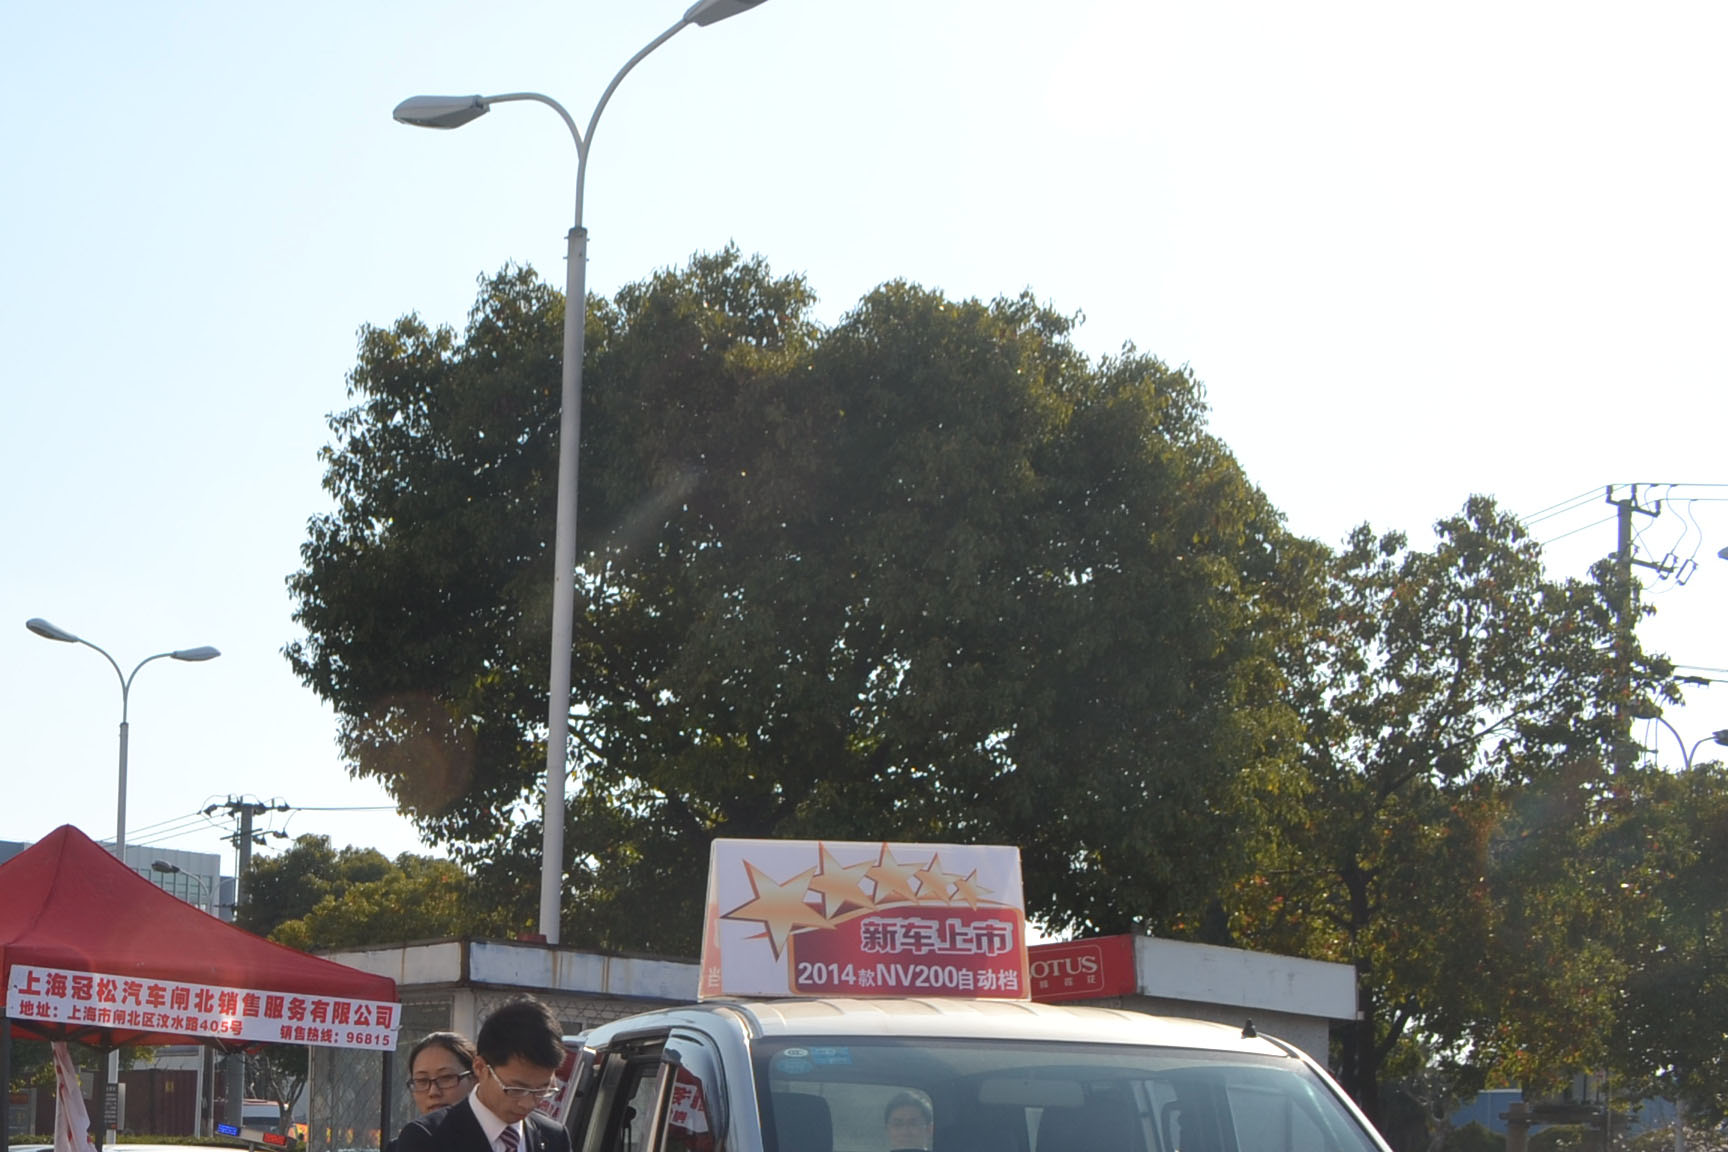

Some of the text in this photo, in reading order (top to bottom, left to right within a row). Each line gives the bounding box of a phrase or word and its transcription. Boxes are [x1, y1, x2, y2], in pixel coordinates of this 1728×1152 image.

[860, 917, 1013, 957] 新车上市
[797, 961, 1019, 991] 2014款NV200自动档
[1029, 956, 1098, 979] OTUS
[18, 970, 393, 1030] 上海冠松汽车闸北销售服务有限公司
